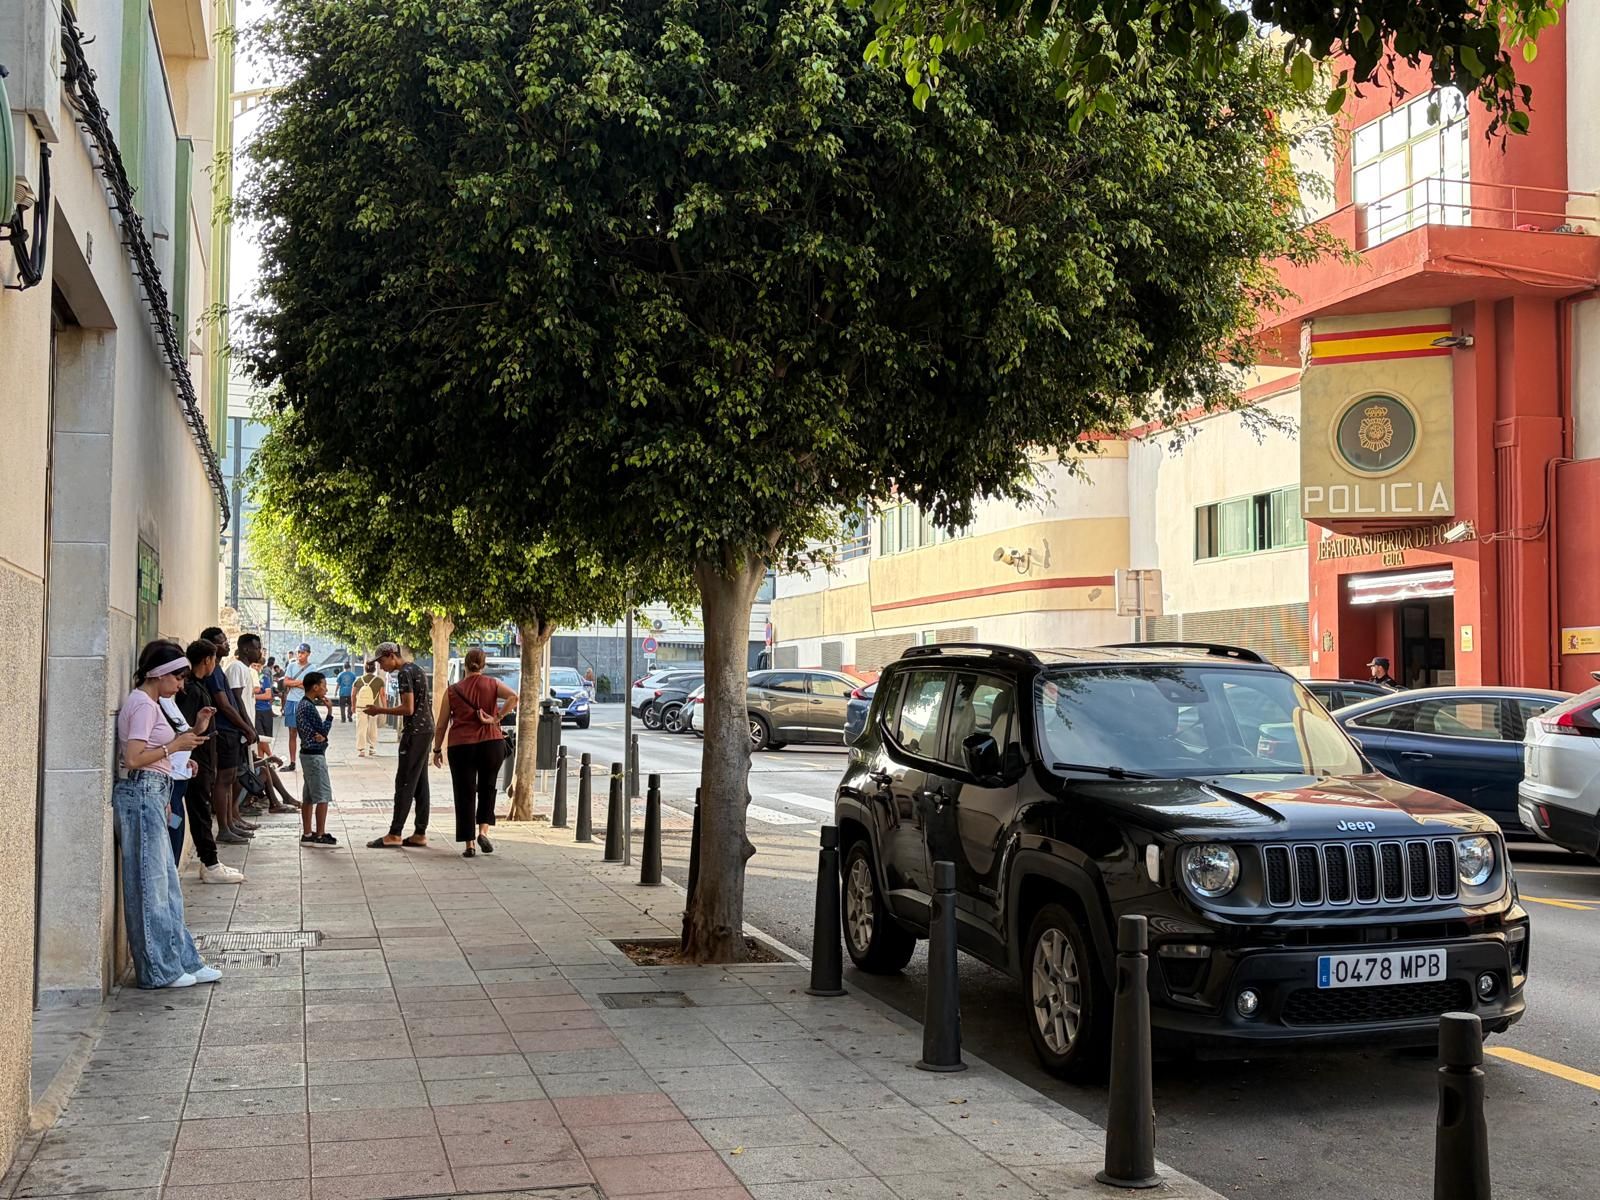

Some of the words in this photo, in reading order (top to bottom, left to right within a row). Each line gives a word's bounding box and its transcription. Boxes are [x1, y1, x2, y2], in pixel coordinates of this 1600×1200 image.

[1304, 482, 1450, 513] POLICIA
[1317, 537, 1363, 561] JEFATURA
[1363, 529, 1413, 554] SUPERIOR
[1415, 527, 1431, 547] DE
[1382, 552, 1404, 566] CEUTA
[1337, 820, 1376, 832] Jeep
[1335, 957, 1392, 982] 0478
[1400, 954, 1440, 979] MPB
